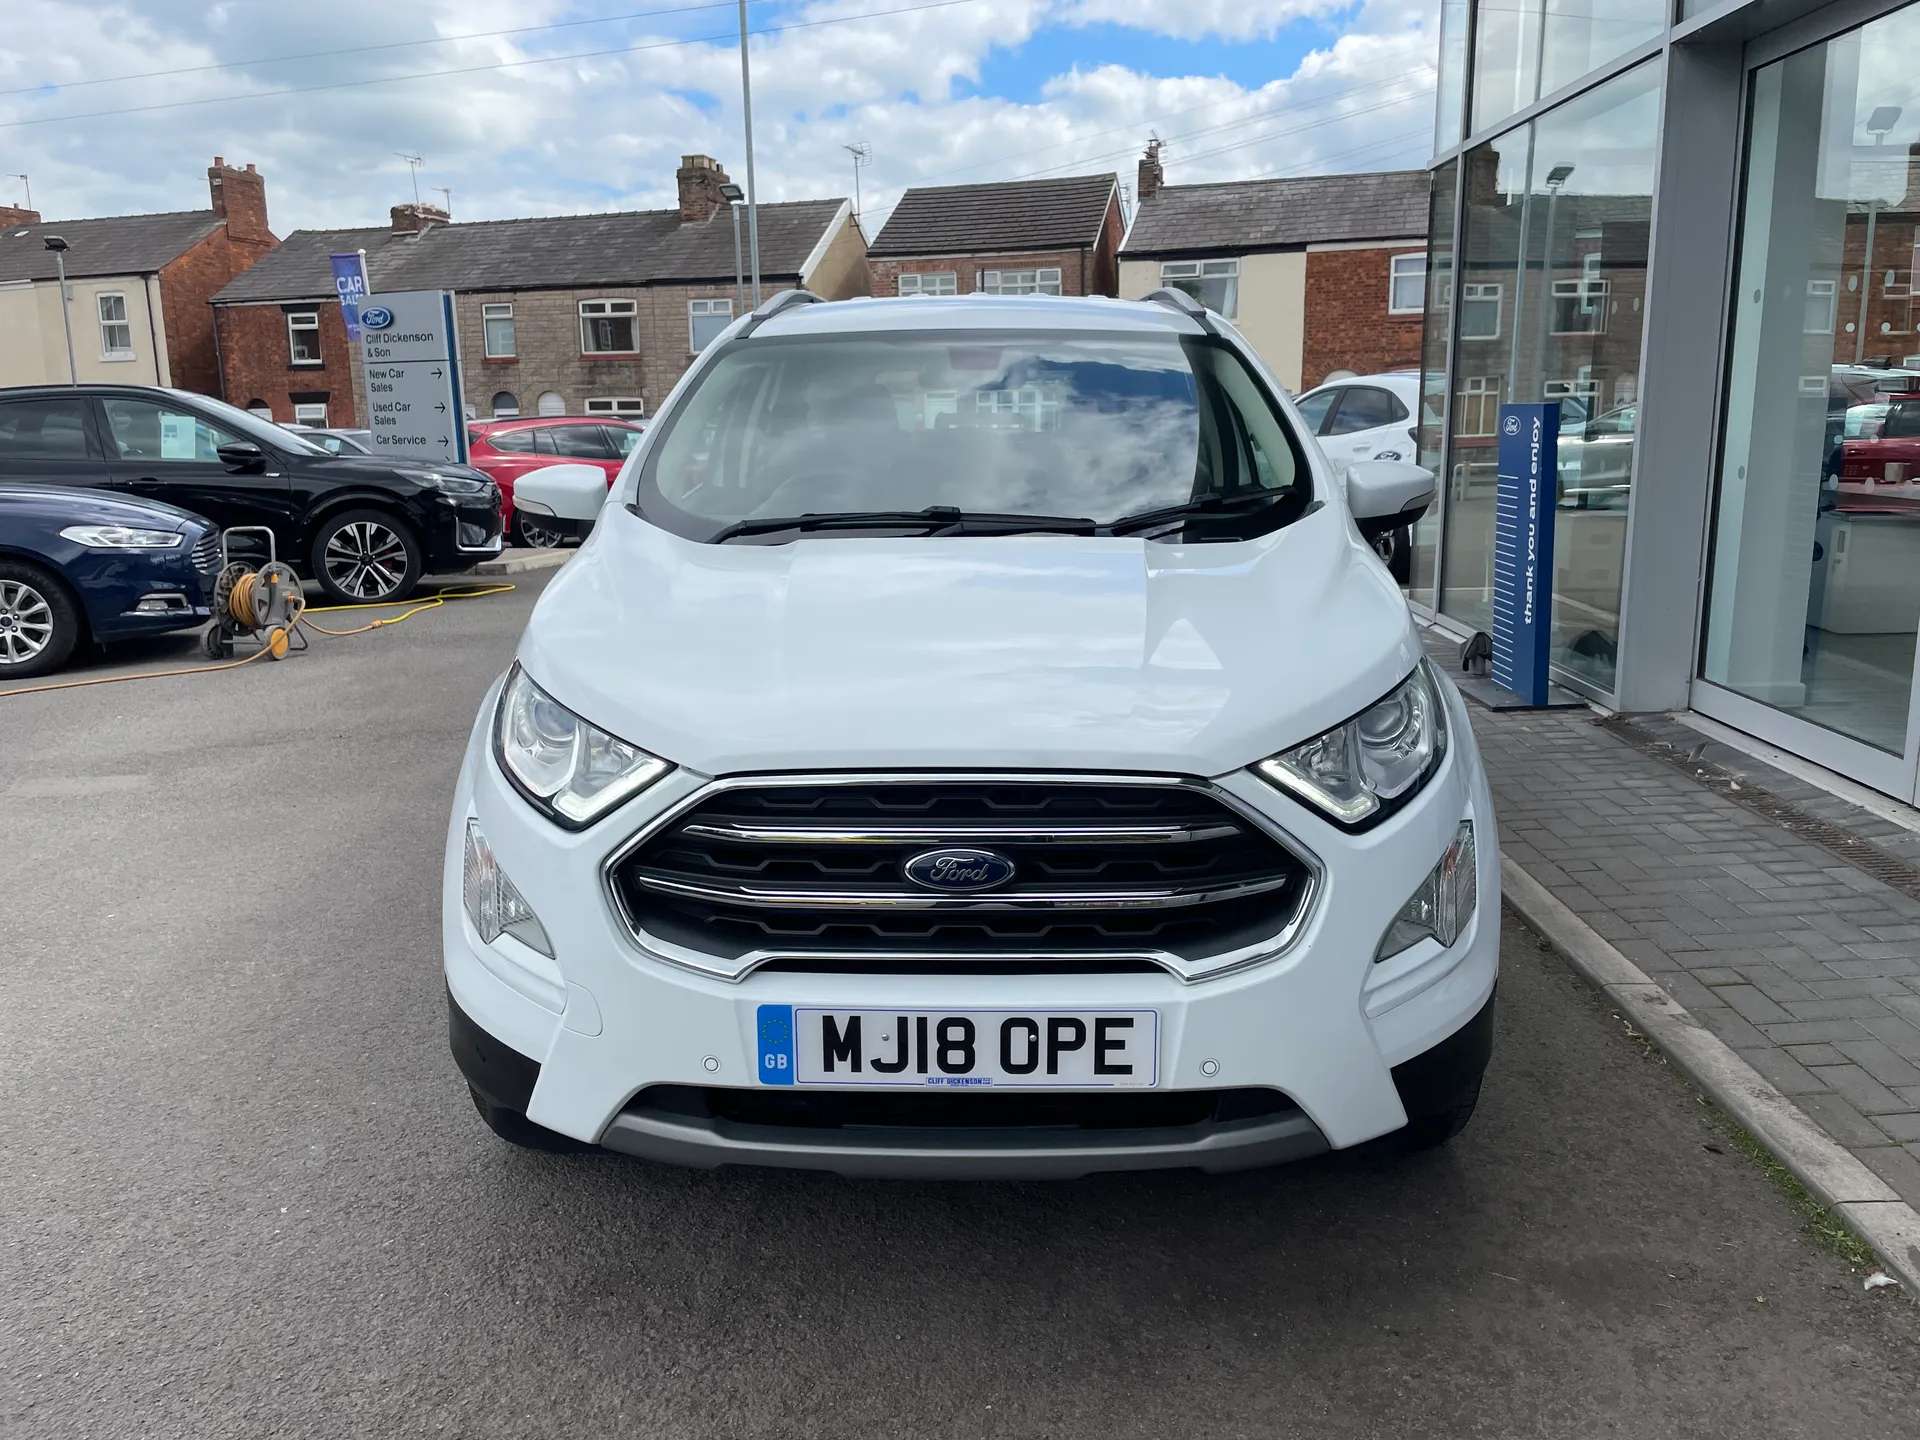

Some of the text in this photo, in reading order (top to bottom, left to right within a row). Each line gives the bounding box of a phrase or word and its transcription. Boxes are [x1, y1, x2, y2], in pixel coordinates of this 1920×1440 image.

[336, 276, 363, 293] CAR
[367, 310, 384, 324] Ford
[366, 332, 434, 344] Cliff Dickenson
[367, 347, 391, 358] & Son
[369, 368, 404, 379] New Car
[371, 382, 393, 392] Sales
[373, 402, 411, 412] Used Car
[374, 415, 396, 425] Sales
[376, 434, 426, 445] Car Service
[1524, 415, 1540, 625] thank you and enjoy
[930, 856, 990, 881] Ford
[821, 1014, 1135, 1076] MJ18 OPE
[764, 1053, 788, 1070] GB
[927, 1077, 944, 1085] CLIFF
